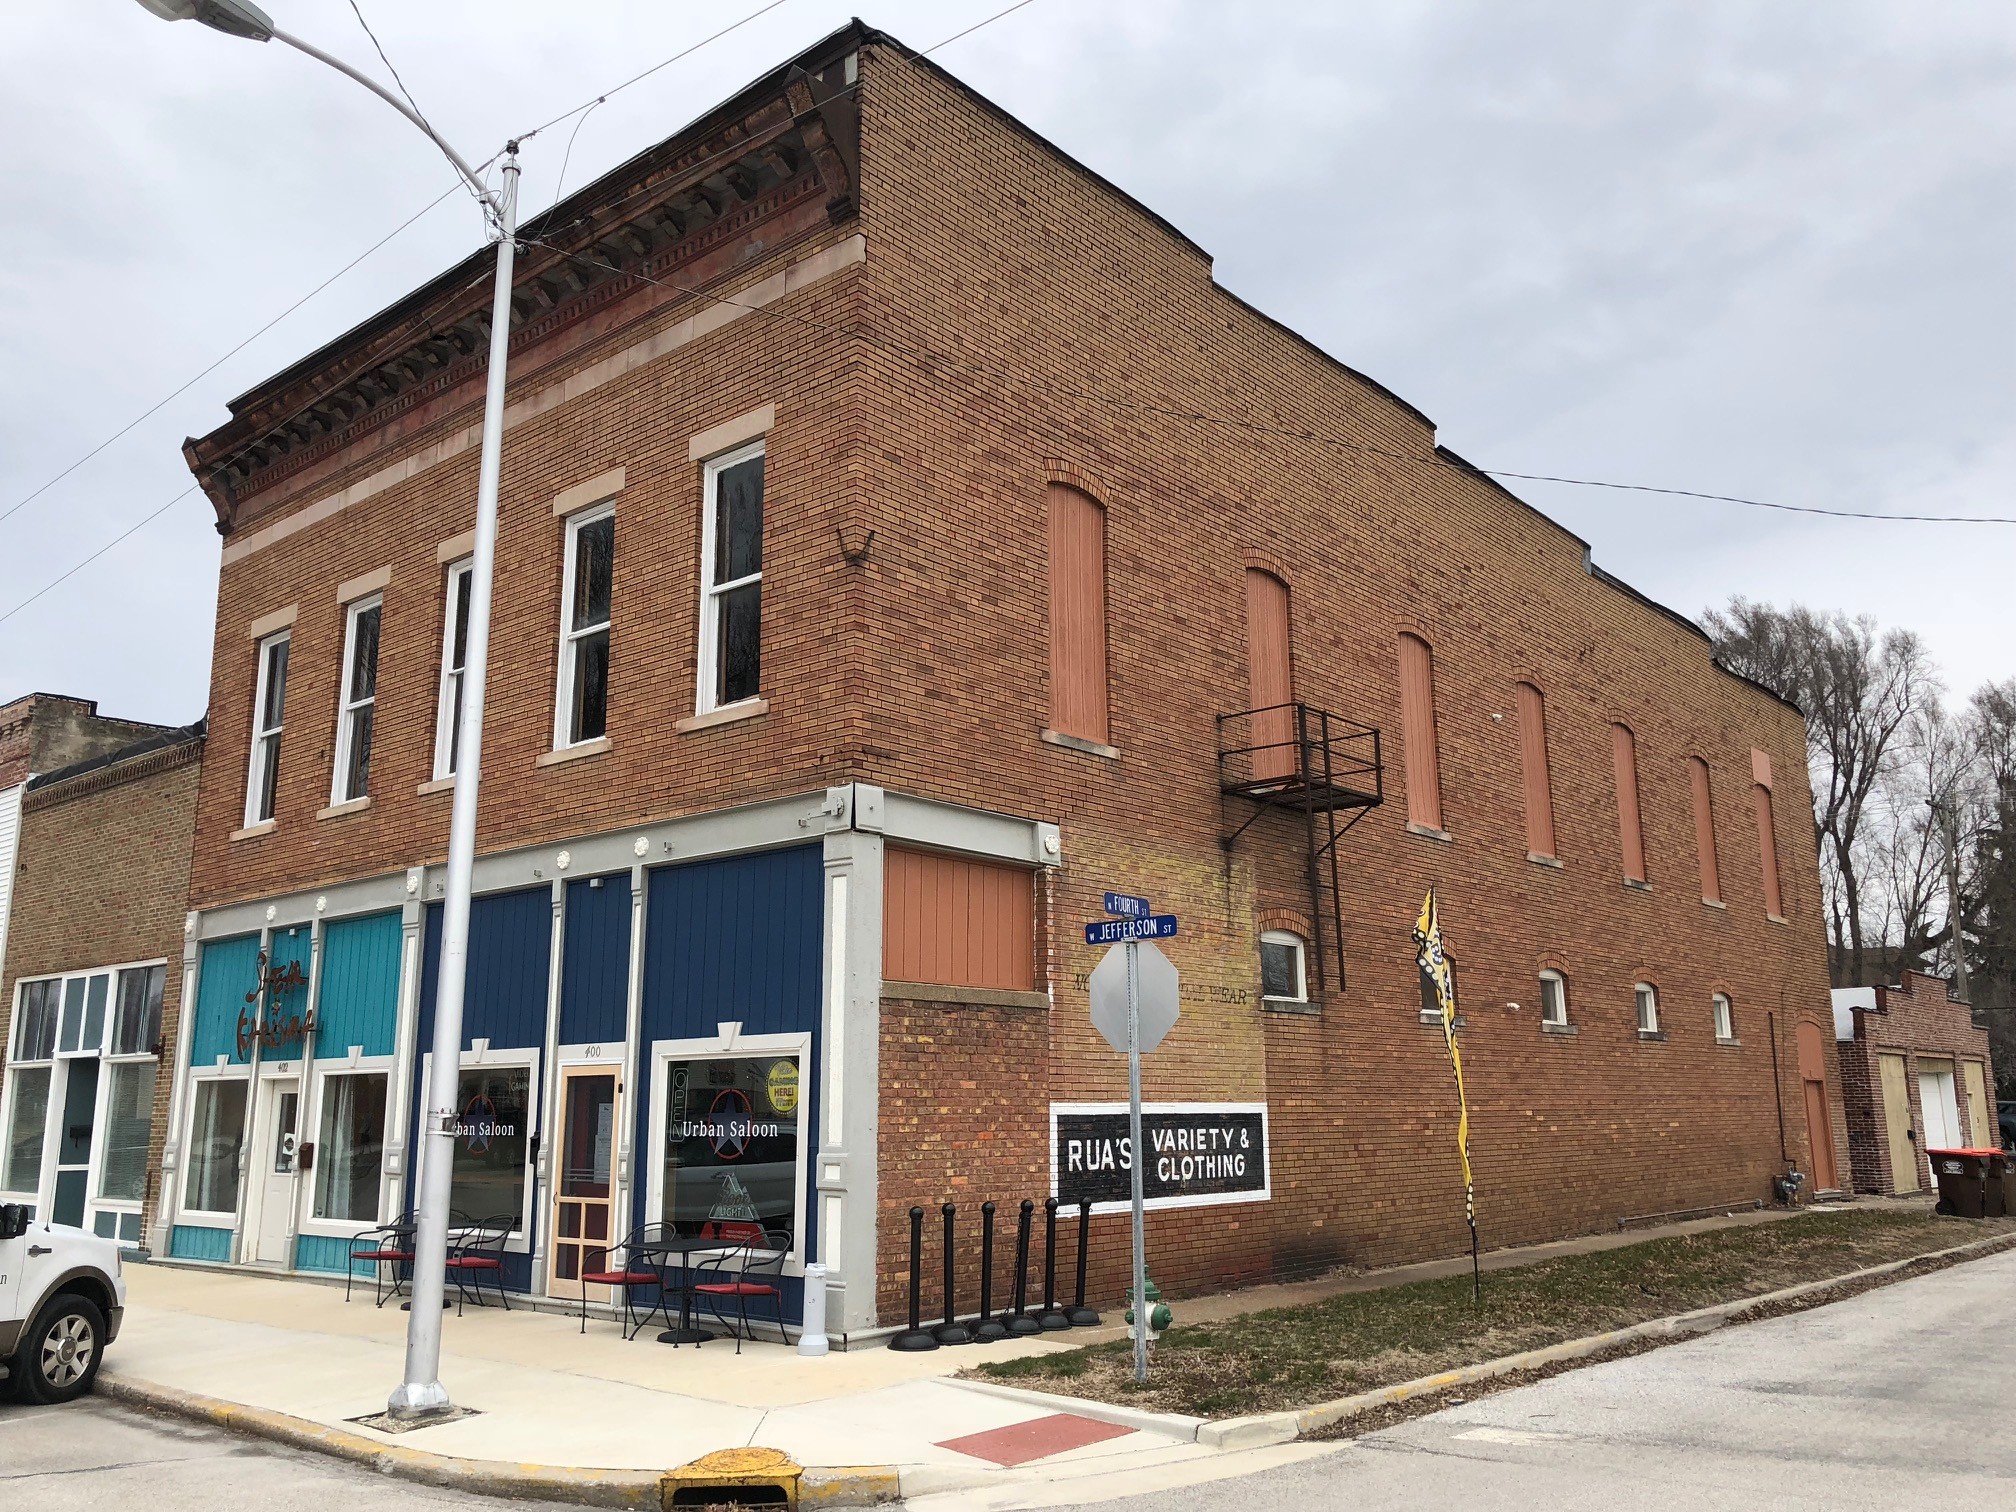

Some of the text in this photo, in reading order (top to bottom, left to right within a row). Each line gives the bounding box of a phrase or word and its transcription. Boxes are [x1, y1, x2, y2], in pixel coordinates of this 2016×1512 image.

[1107, 896, 1147, 916] N FOURTH ST
[1089, 919, 1172, 941] W JEFFERSON ST
[585, 1045, 601, 1058] 400
[277, 1062, 289, 1072] 402
[673, 1072, 687, 1138] OPEN
[479, 1121, 515, 1136] Saloon
[682, 1120, 778, 1137] Urban Saloon
[1152, 1127, 1250, 1152] VARIETY &
[1068, 1137, 1132, 1172] RUA'S
[1157, 1153, 1246, 1182] CLOTHING
